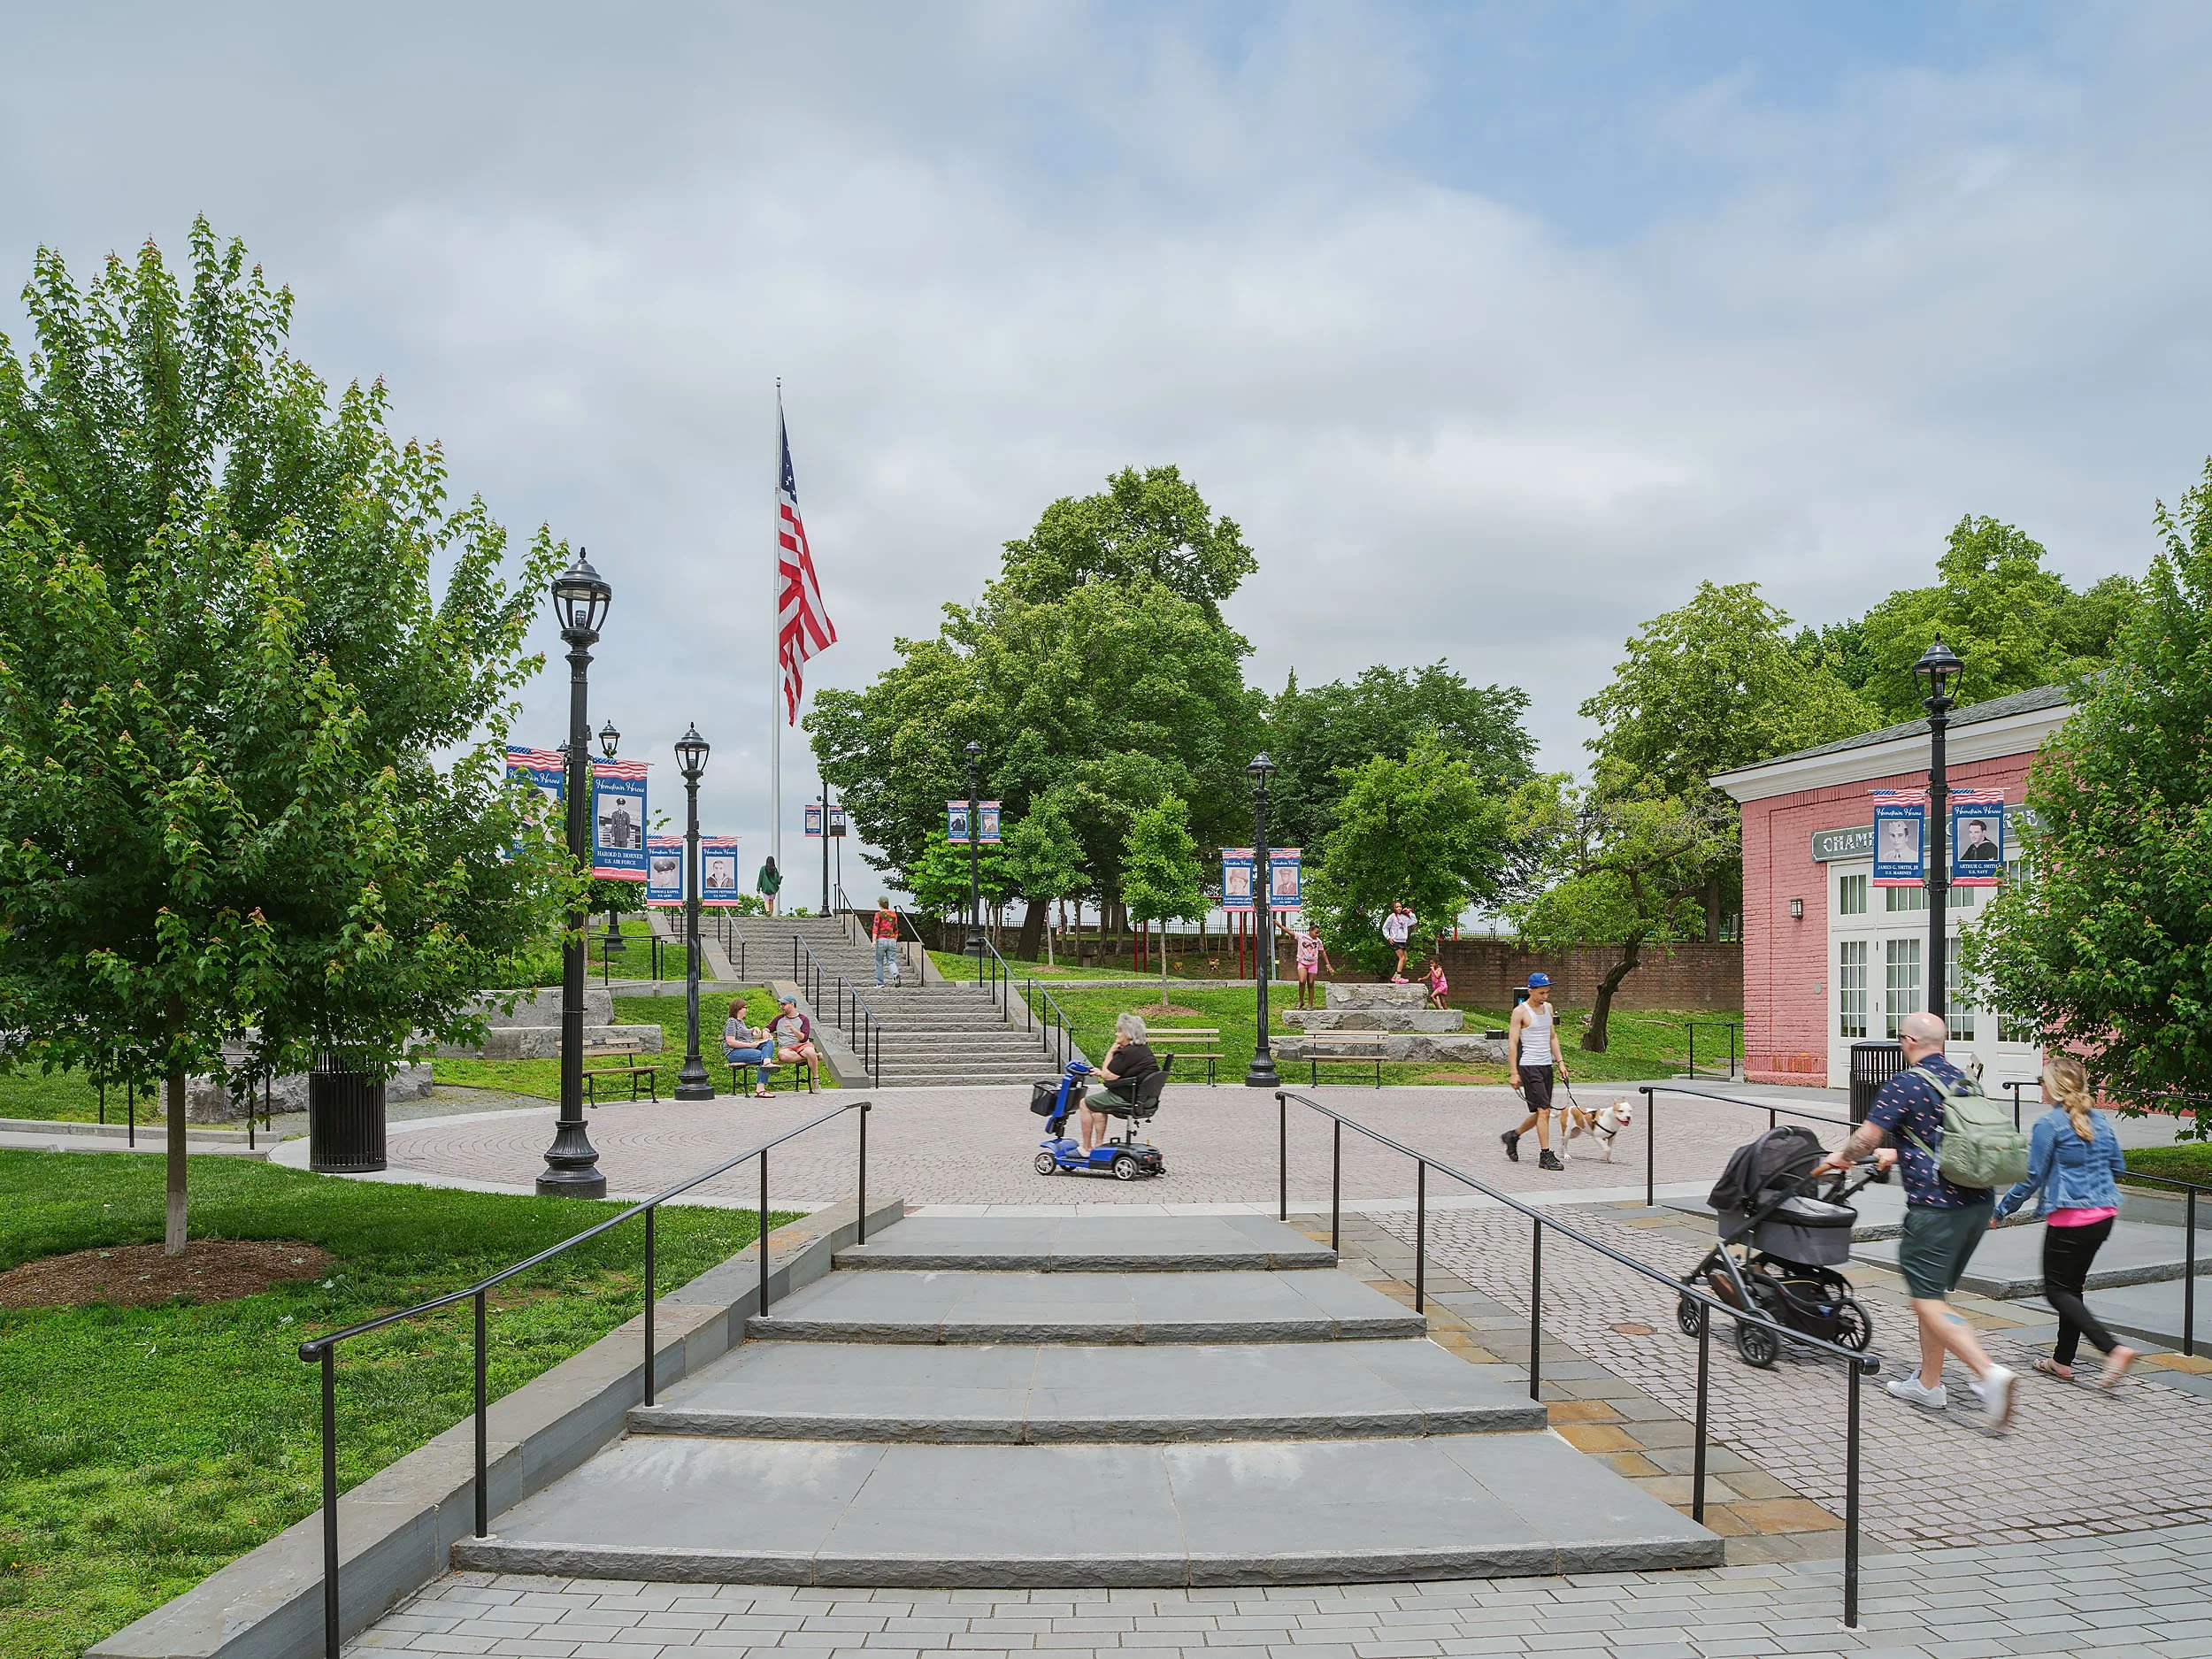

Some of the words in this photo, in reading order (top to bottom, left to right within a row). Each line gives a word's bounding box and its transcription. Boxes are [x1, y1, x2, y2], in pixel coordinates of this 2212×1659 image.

[540, 772, 560, 784] Heroes
[595, 779, 626, 791] Hometown
[626, 781, 644, 793] Heroes
[1876, 807, 1903, 816] Hometown
[1954, 806, 1982, 815] Hometown
[1823, 832, 1874, 852] CHAM
